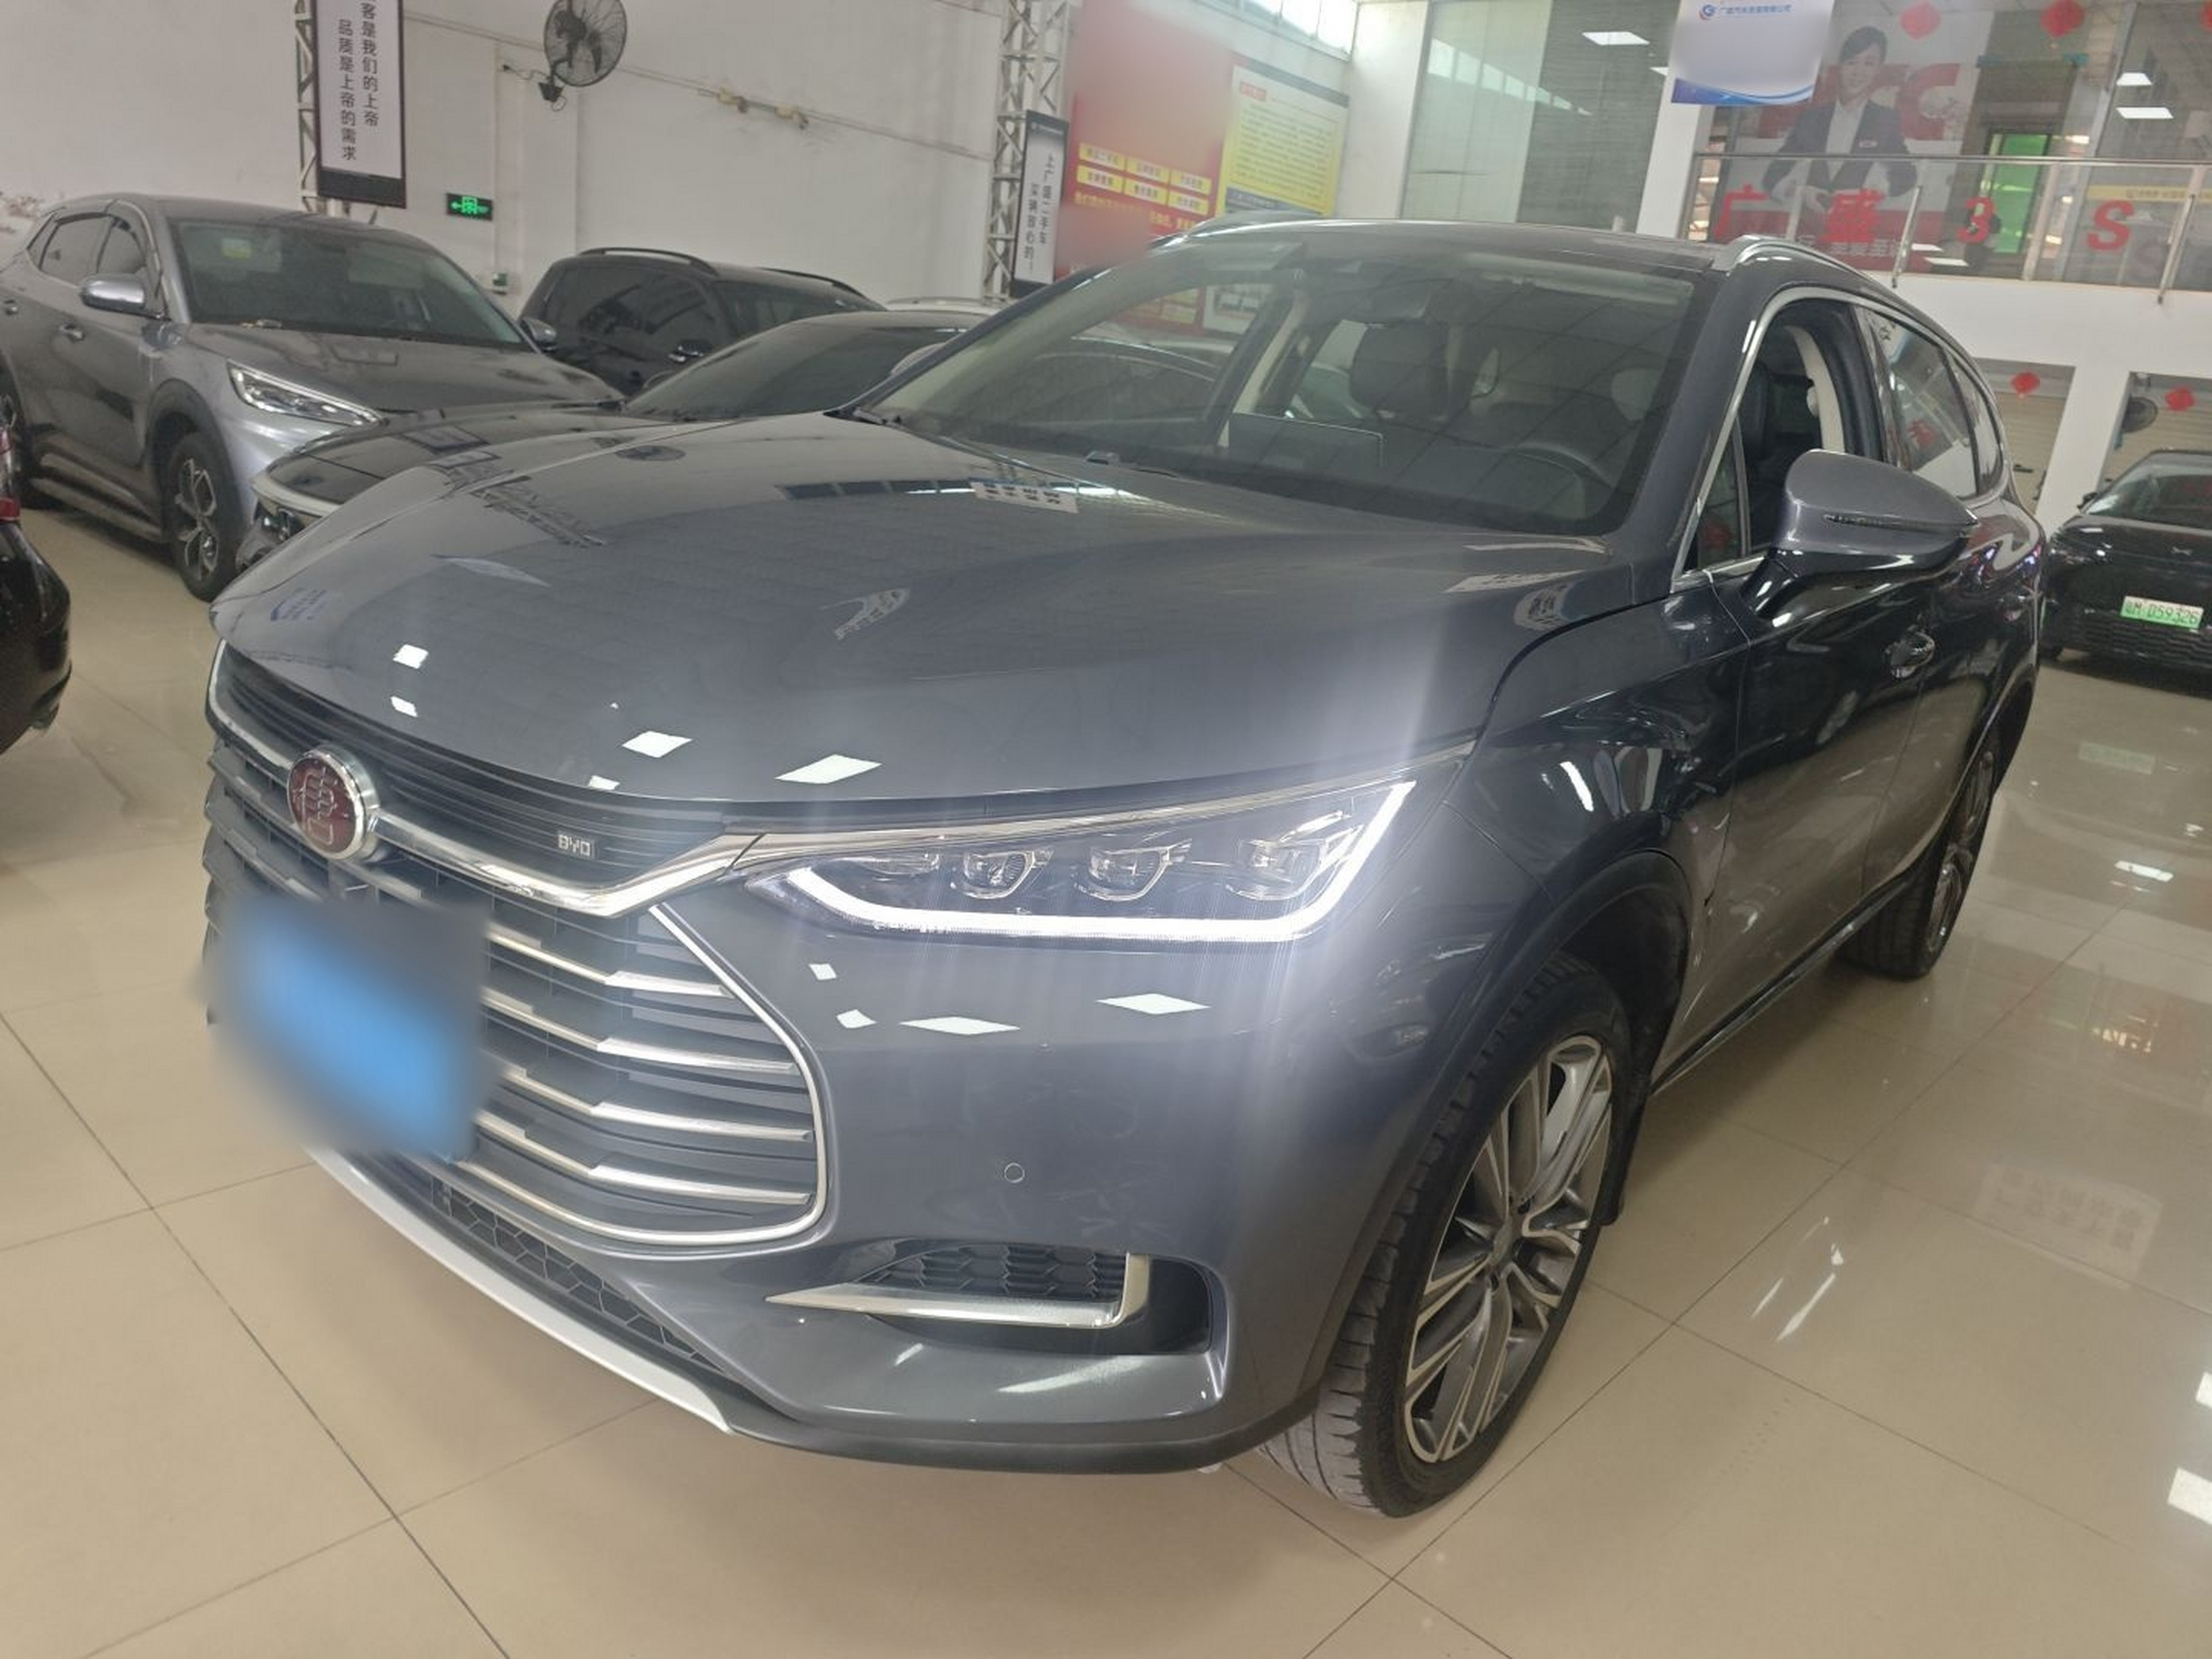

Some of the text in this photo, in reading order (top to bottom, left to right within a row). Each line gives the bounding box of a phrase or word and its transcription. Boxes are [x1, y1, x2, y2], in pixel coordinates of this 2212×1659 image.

[338, 19, 357, 161] 品质是上帝的需求
[558, 834, 590, 856] BYD
